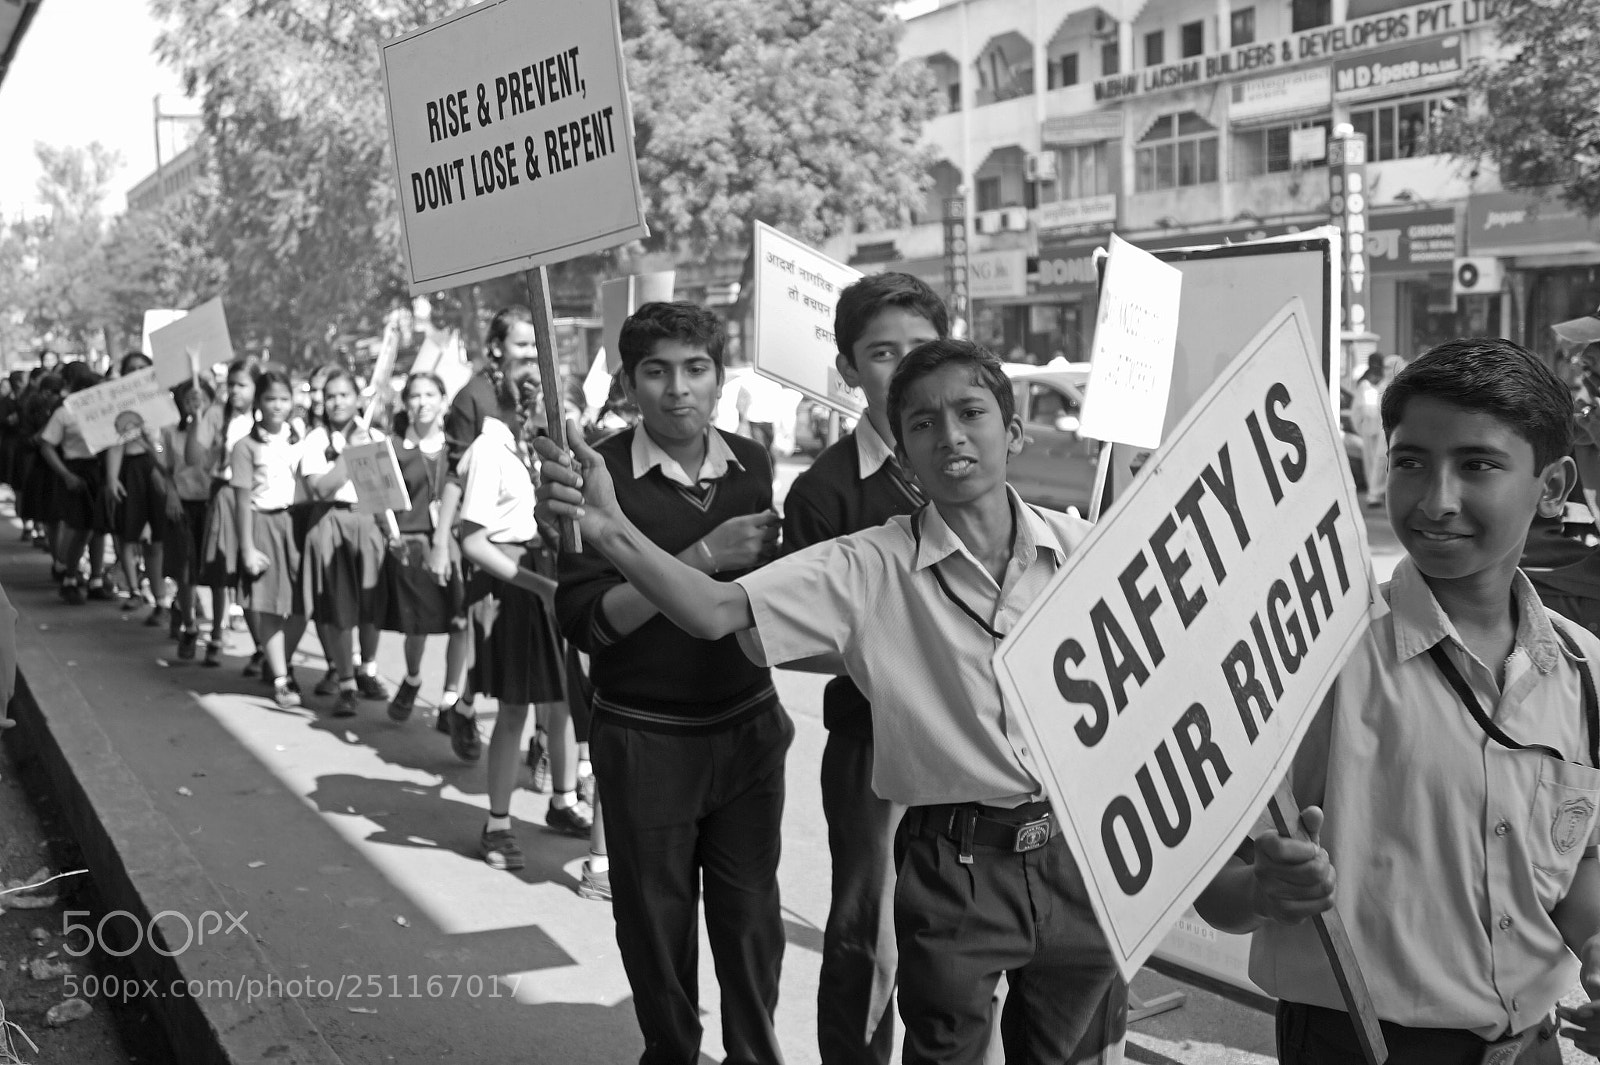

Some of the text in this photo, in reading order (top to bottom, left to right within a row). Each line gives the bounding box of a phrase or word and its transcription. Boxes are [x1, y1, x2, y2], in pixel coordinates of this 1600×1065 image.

[1206, 41, 1275, 78] BUILDERS
[1282, 40, 1292, 62] &
[1300, 14, 1409, 58] DEVELOPERS
[1417, 4, 1456, 34] PVT.
[1371, 60, 1420, 86] Space
[427, 47, 586, 143] RISE & PREVENT,
[411, 107, 615, 214] DON'T LOSE & REPENT
[766, 251, 795, 273] आदर्श
[799, 266, 834, 294] नागरिक
[788, 285, 831, 317] तो बचपन
[1053, 442, 1251, 748] SAFETY
[1245, 382, 1307, 506] IS
[1101, 702, 1233, 896] OUR
[1220, 500, 1350, 746] RIGHT
